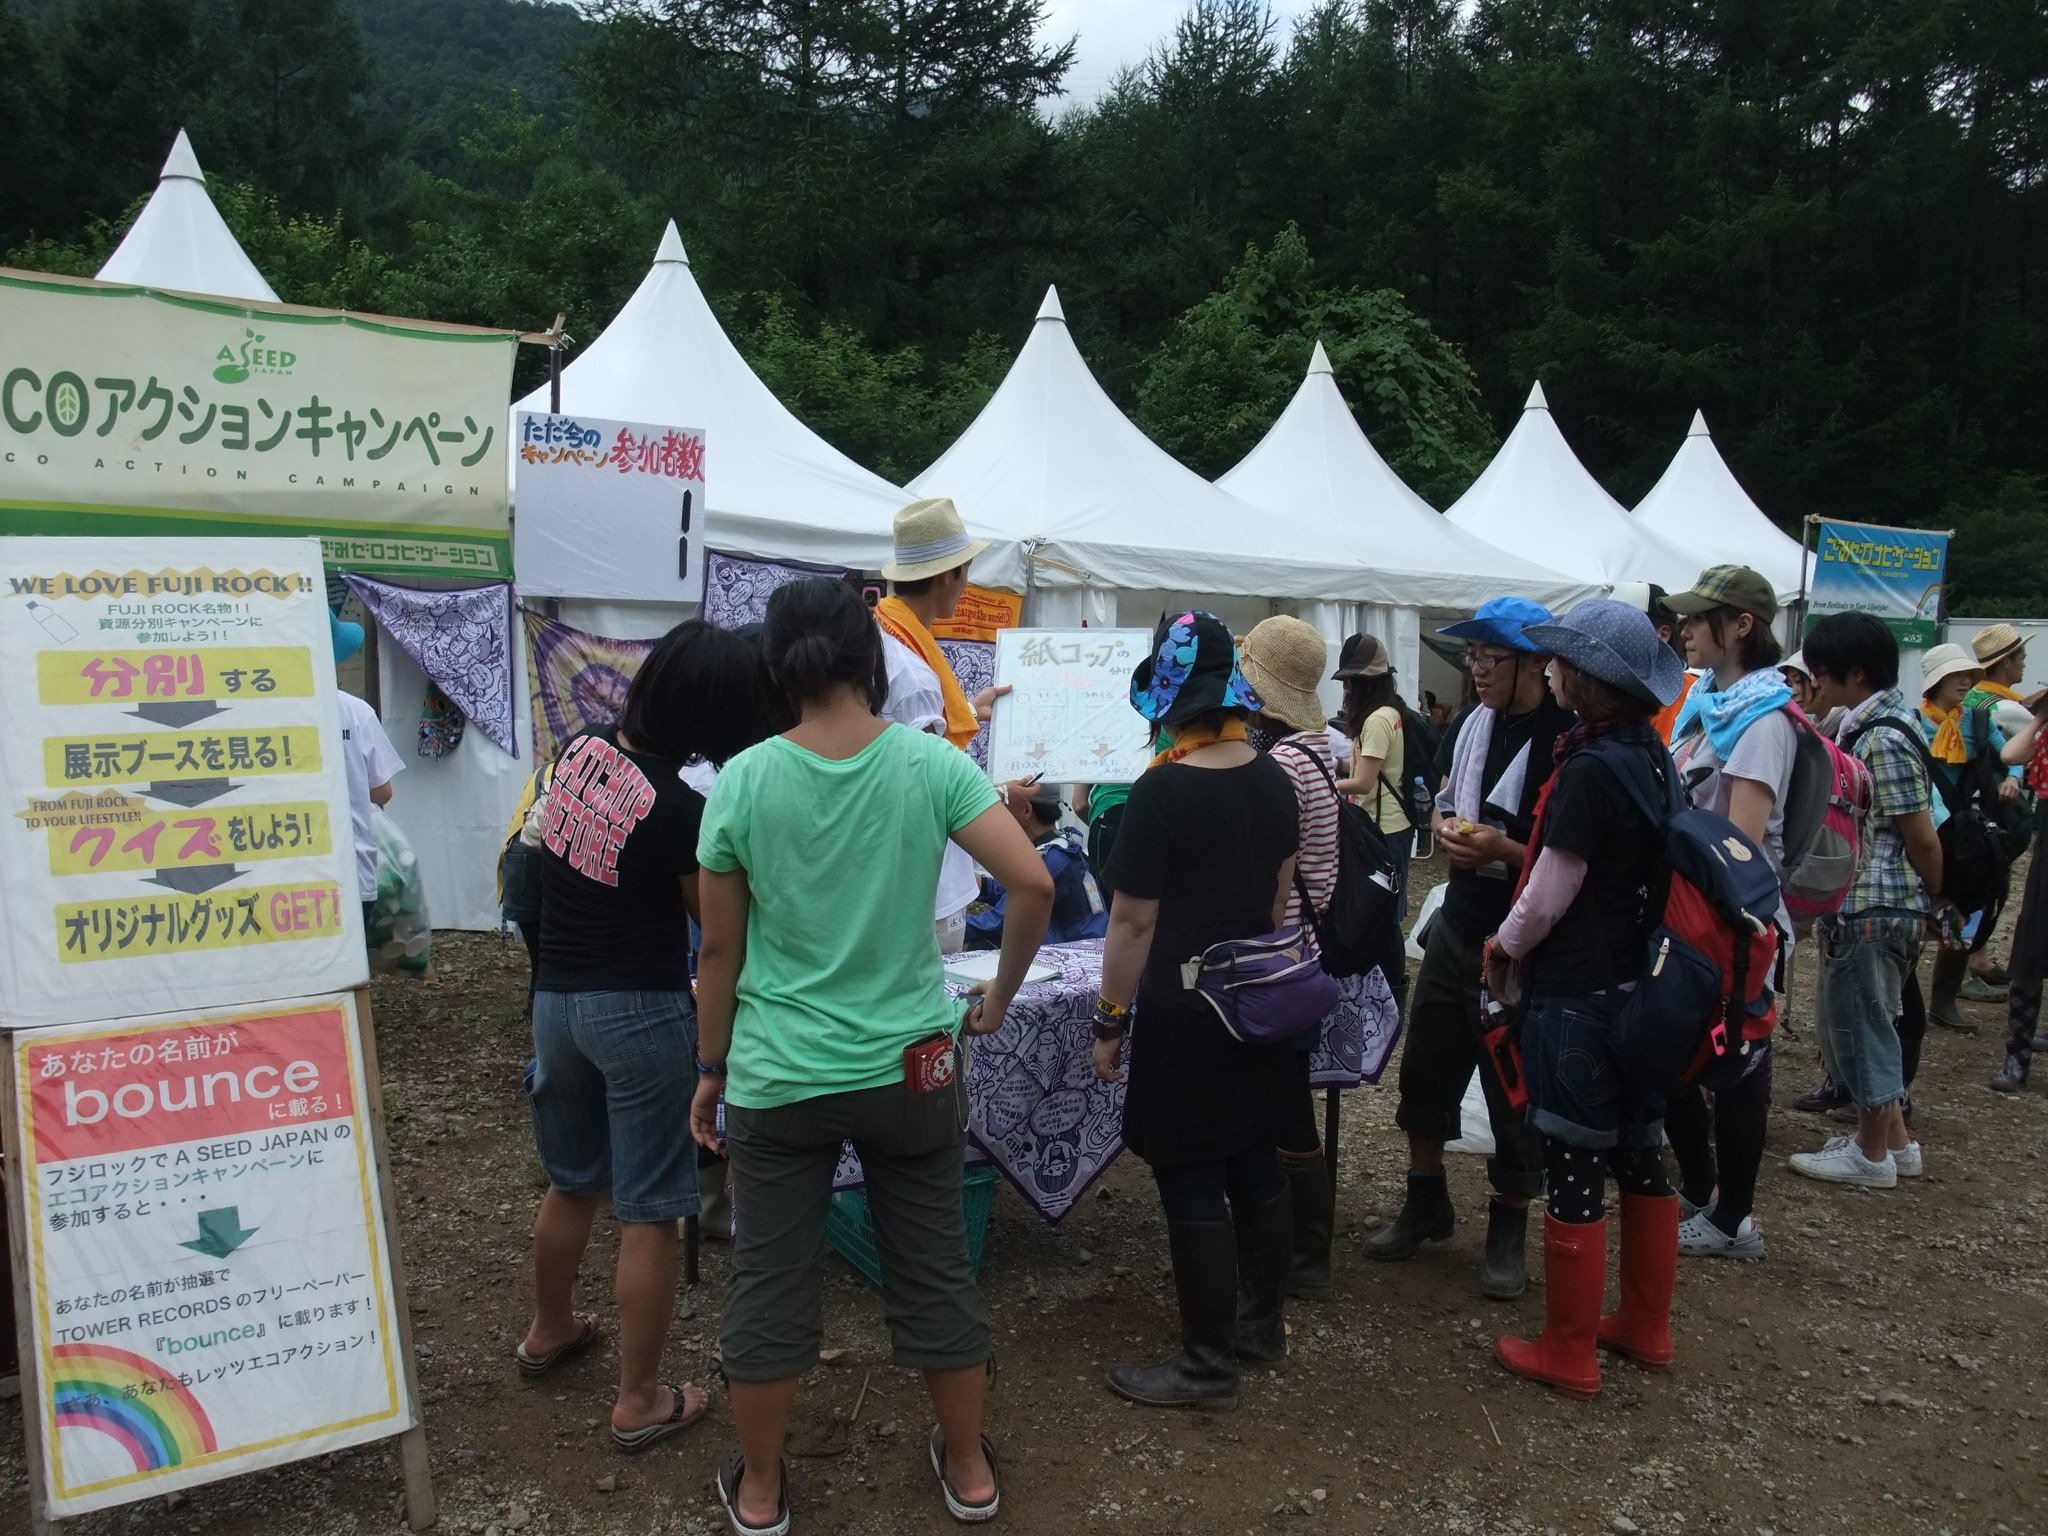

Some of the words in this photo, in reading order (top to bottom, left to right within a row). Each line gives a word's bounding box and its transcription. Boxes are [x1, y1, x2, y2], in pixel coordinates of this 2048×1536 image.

[216, 344, 236, 362] A
[254, 367, 293, 376] JAPAN
[524, 415, 601, 448] ただ今の
[521, 443, 609, 468] キャンペーン
[609, 427, 706, 482] 参加者数
[95, 458, 247, 480] ACTION
[288, 474, 478, 496] CAMPAIGN
[9, 577, 55, 594] WE
[65, 577, 138, 594] LOVE
[148, 577, 204, 596] FUJI
[213, 576, 290, 593] ROCK
[98, 616, 264, 631] 資源分別キャンペーンに
[107, 604, 146, 616] FUJI
[136, 630, 228, 643] 参加しよう！！
[81, 654, 206, 698] 分別
[220, 668, 278, 693] する
[64, 735, 293, 780] 展示ブースを見る！
[25, 818, 41, 828] TO
[44, 816, 77, 827] YOUR
[79, 811, 142, 825] LIFESTYLE!!
[33, 800, 68, 812] FROM
[71, 799, 94, 812] FUJI
[96, 796, 129, 808] ROCK
[69, 817, 223, 867] クイズ
[228, 813, 313, 851] をしよう！
[541, 779, 628, 887] BEFORE
[65, 893, 262, 955] オリジナルグッズ
[40, 1031, 240, 1078] あなたの名前が
[64, 1059, 320, 1127] bounce
[269, 1093, 343, 1120] に載る！
[46, 1152, 168, 1186] フジロックで
[174, 1149, 190, 1166] A
[196, 1140, 252, 1162] SEED
[259, 1127, 328, 1152] JAPAN
[334, 1124, 351, 1139] の
[48, 1149, 324, 1209] エコアクションキャンペーンに
[56, 1268, 231, 1315] あなたの名前が抽選で
[57, 1319, 132, 1344] TOWER
[139, 1296, 231, 1328] RECORDS
[236, 1272, 366, 1307] のフリーペーパー
[278, 1296, 373, 1330] に載ります！
